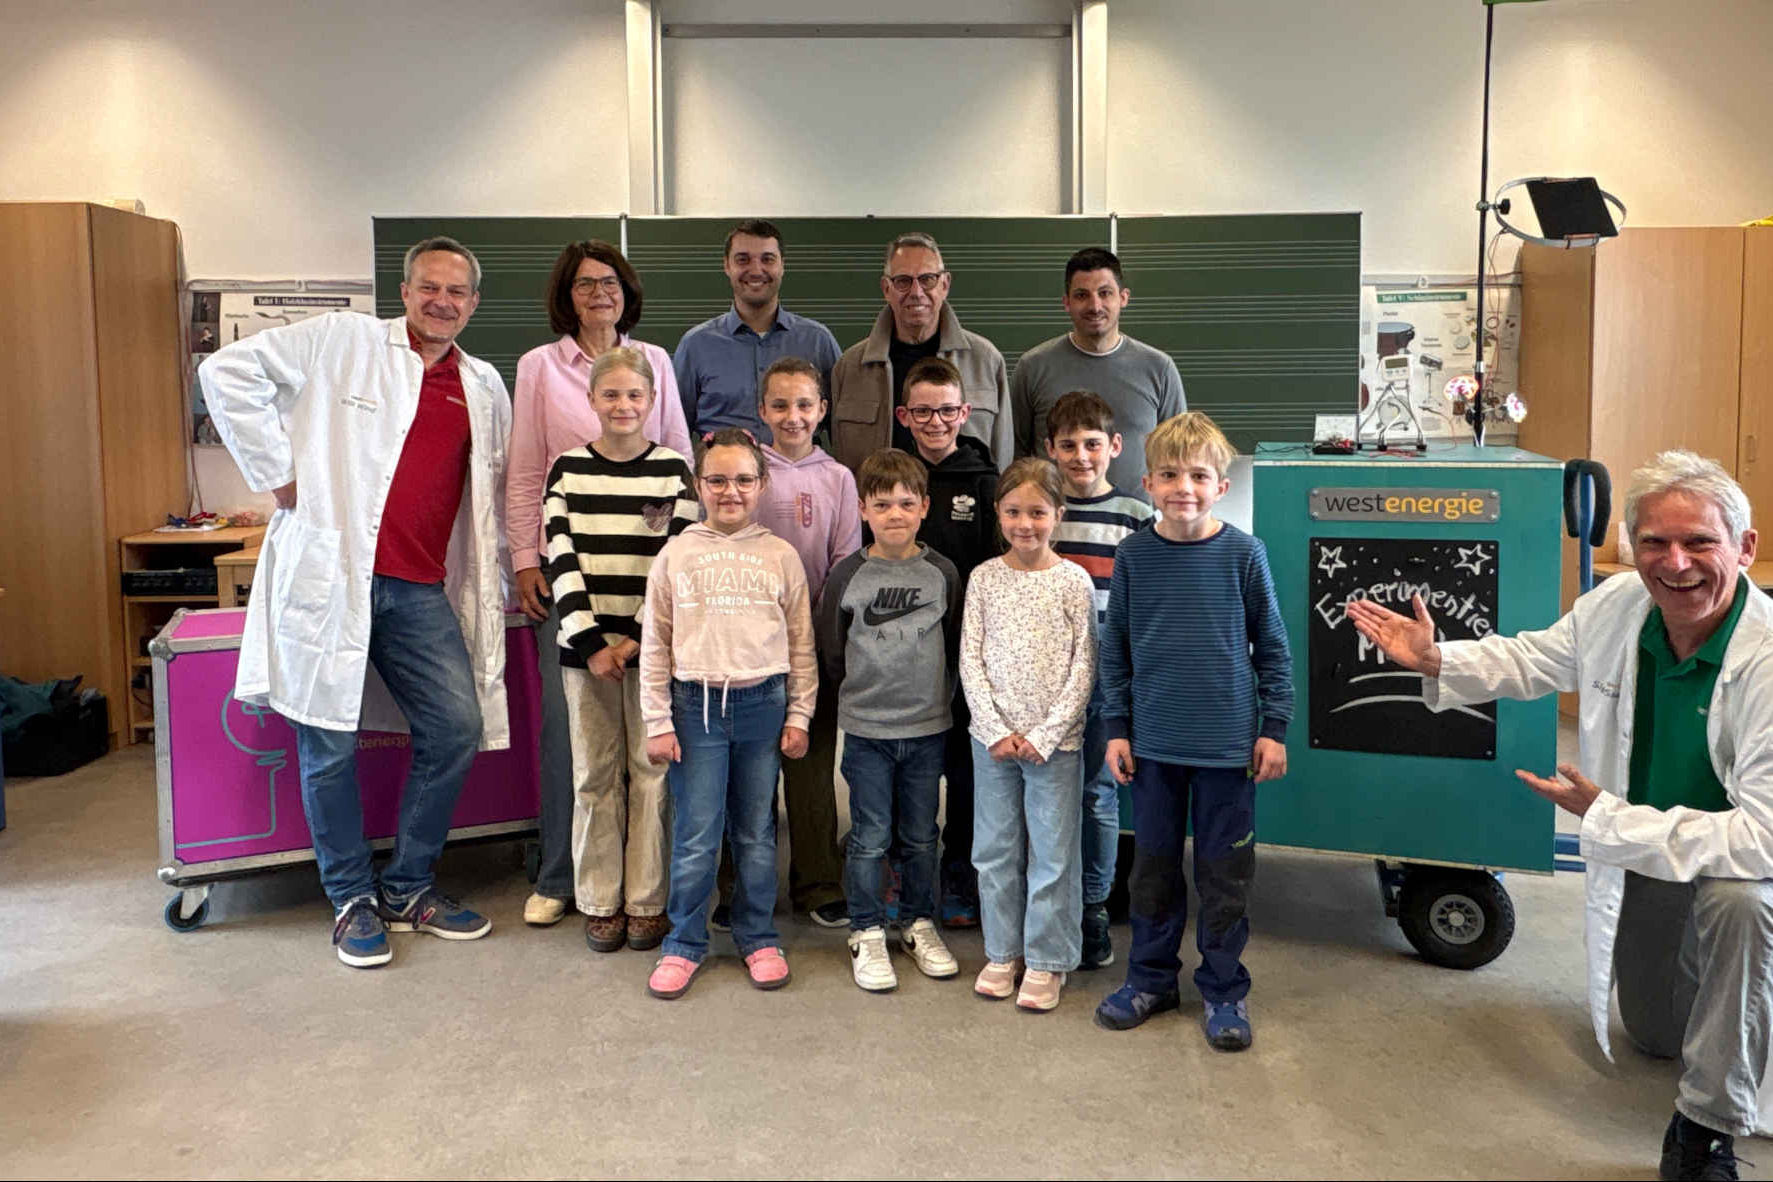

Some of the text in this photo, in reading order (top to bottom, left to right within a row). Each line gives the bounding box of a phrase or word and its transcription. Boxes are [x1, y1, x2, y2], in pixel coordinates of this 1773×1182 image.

[1325, 492, 1484, 520] westenergie
[697, 552, 735, 565] SOUTH
[677, 567, 779, 598] MIAMI
[705, 595, 751, 606] FLORIDA
[872, 587, 922, 609] NIKE
[1314, 581, 1494, 638] Experimentie
